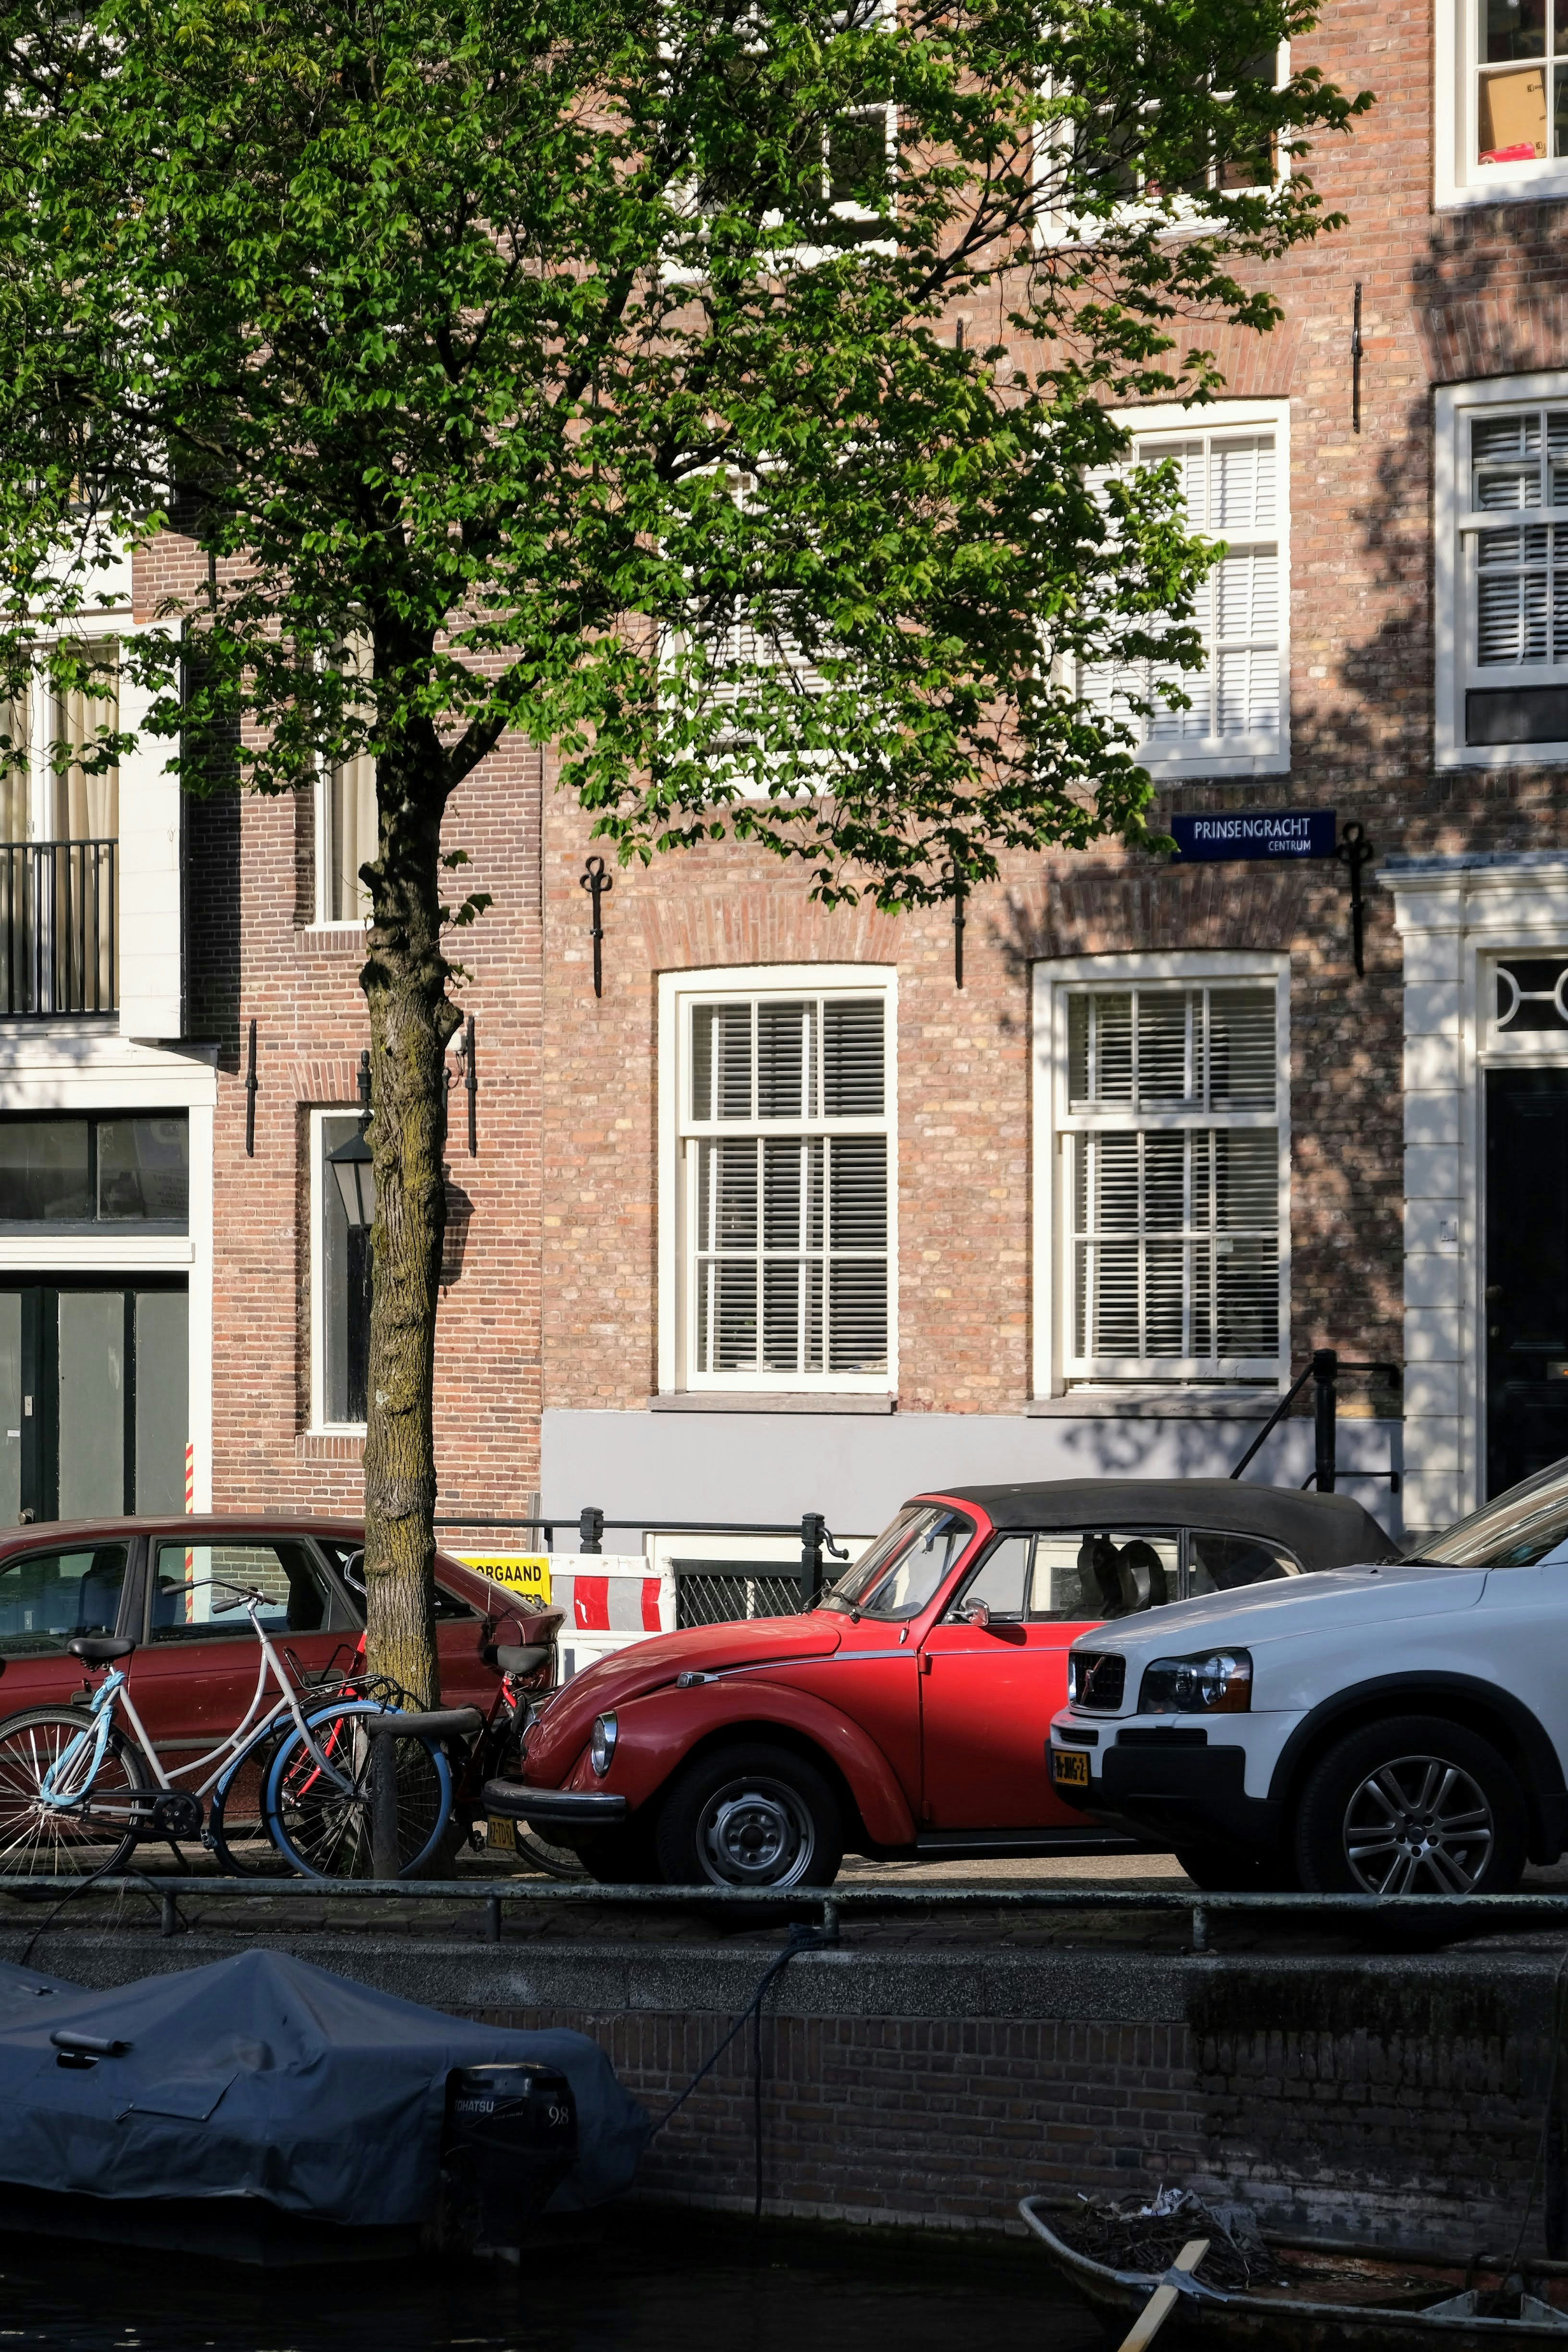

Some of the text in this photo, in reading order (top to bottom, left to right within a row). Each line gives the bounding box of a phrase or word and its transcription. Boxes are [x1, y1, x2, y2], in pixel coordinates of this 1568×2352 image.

[1194, 818, 1310, 839] PRINSENGRACHT
[1268, 840, 1311, 851] CENTRUM
[471, 1566, 541, 1581] ORGAAND
